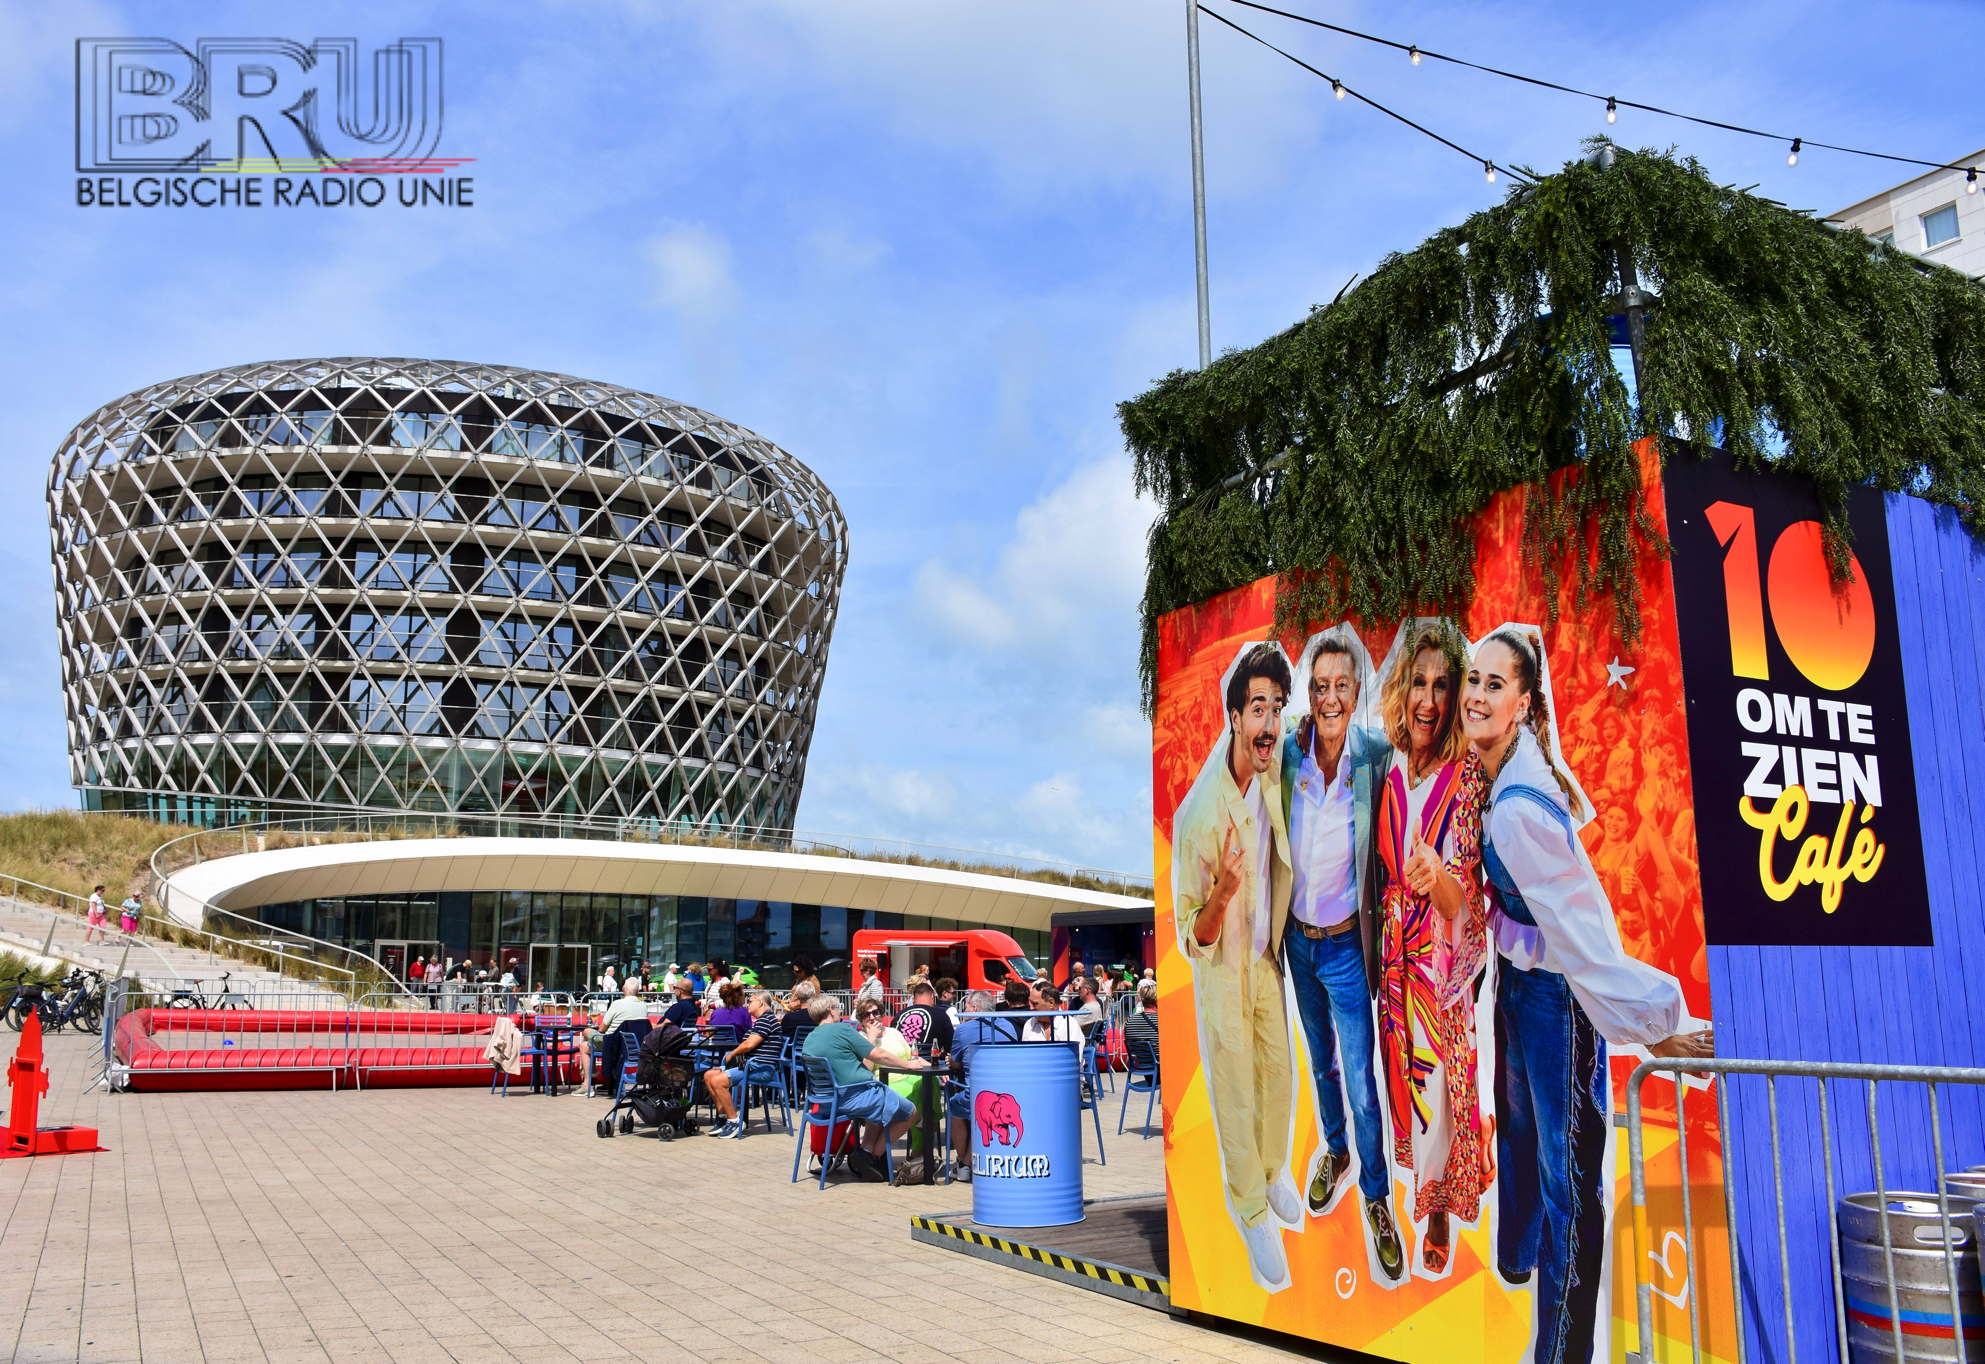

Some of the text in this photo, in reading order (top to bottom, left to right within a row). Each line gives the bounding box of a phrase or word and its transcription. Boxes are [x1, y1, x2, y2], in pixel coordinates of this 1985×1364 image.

[1704, 500, 1876, 691] 10
[1736, 688, 1876, 745] OM TE
[1741, 741, 1883, 807] ZIEN
[1739, 784, 1886, 914] Café
[972, 1152, 1051, 1178] ELIRIUM
